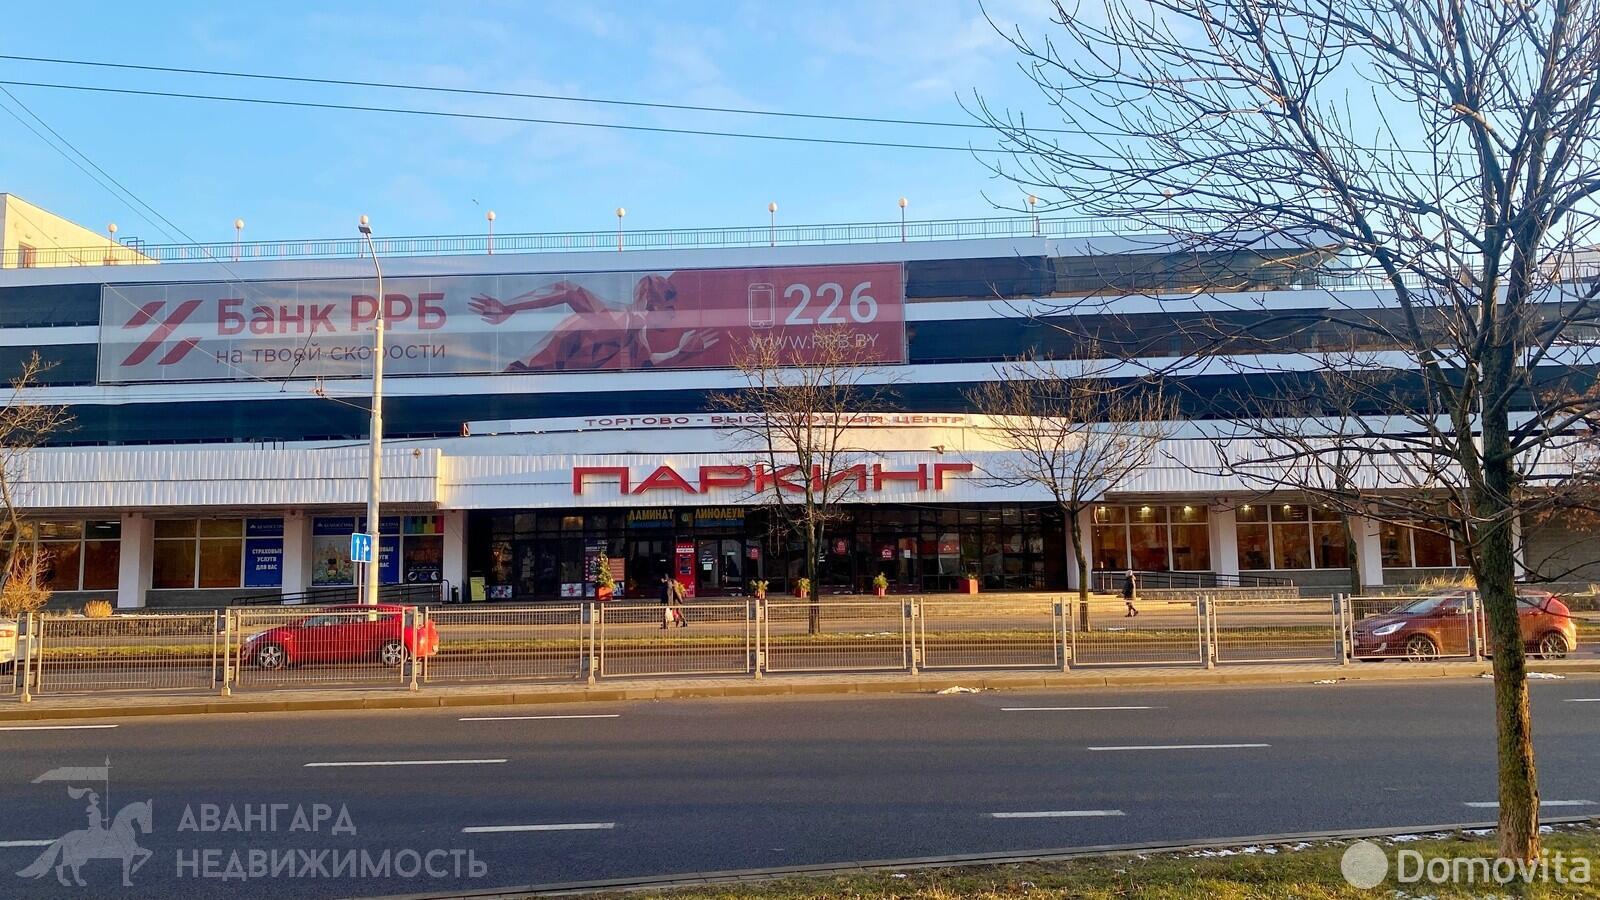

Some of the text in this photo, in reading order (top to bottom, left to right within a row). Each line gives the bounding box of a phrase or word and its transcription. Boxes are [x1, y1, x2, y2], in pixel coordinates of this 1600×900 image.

[784, 281, 878, 325] 226
[217, 292, 448, 336] Банк РРБ
[216, 349, 243, 364] на
[250, 343, 321, 363] твоей
[584, 416, 689, 427] ТОРГОВО
[892, 415, 966, 425] ЦЕНТР
[573, 463, 973, 495] ПАРКИНГ
[629, 508, 674, 520] ЛАМИНАТ
[695, 507, 745, 519] ЛИНОЛЕУМ
